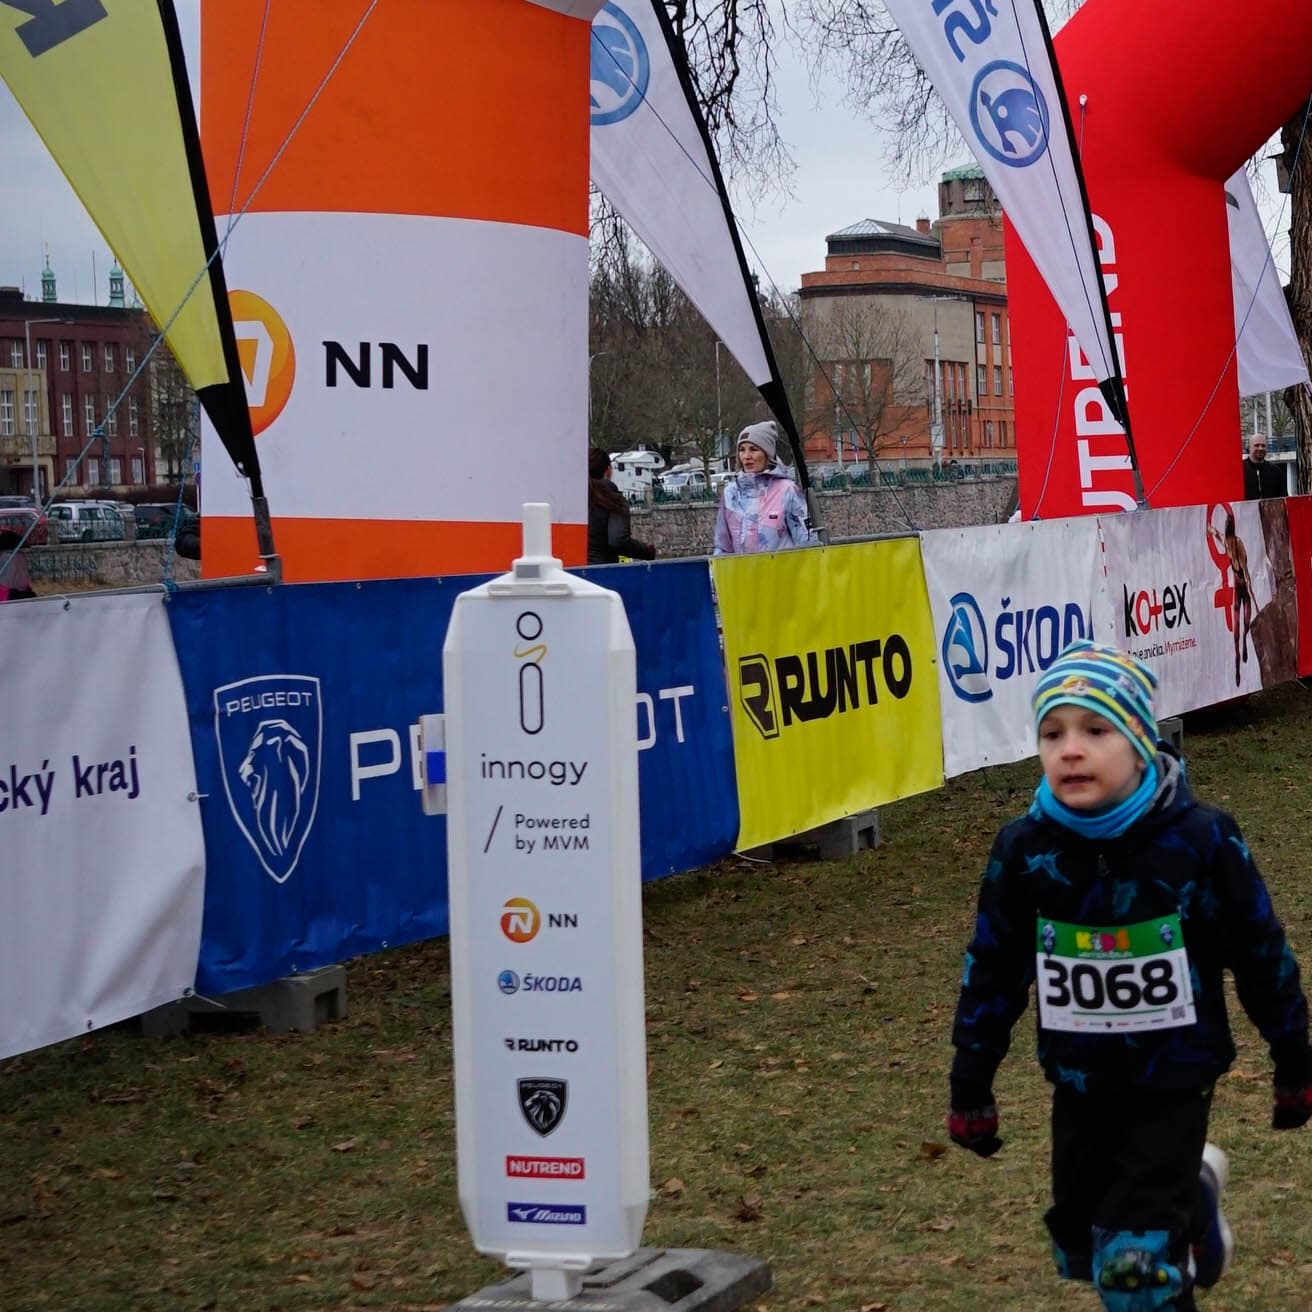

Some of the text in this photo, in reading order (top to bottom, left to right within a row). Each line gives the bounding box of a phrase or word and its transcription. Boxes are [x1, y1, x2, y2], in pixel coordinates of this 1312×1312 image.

[322, 341, 429, 390] NN
[1124, 582, 1191, 637] kotex
[775, 634, 912, 726] RUNTO
[226, 691, 313, 717] PEUGEOT
[73, 745, 140, 799] kraj
[481, 753, 588, 786] innogy
[514, 814, 590, 829] Powered
[515, 836, 590, 854] by MVM
[548, 914, 578, 928] NN
[523, 973, 583, 992] ŠKODA
[1043, 959, 1178, 1009] 3068
[509, 1159, 582, 1175] NUTREND
